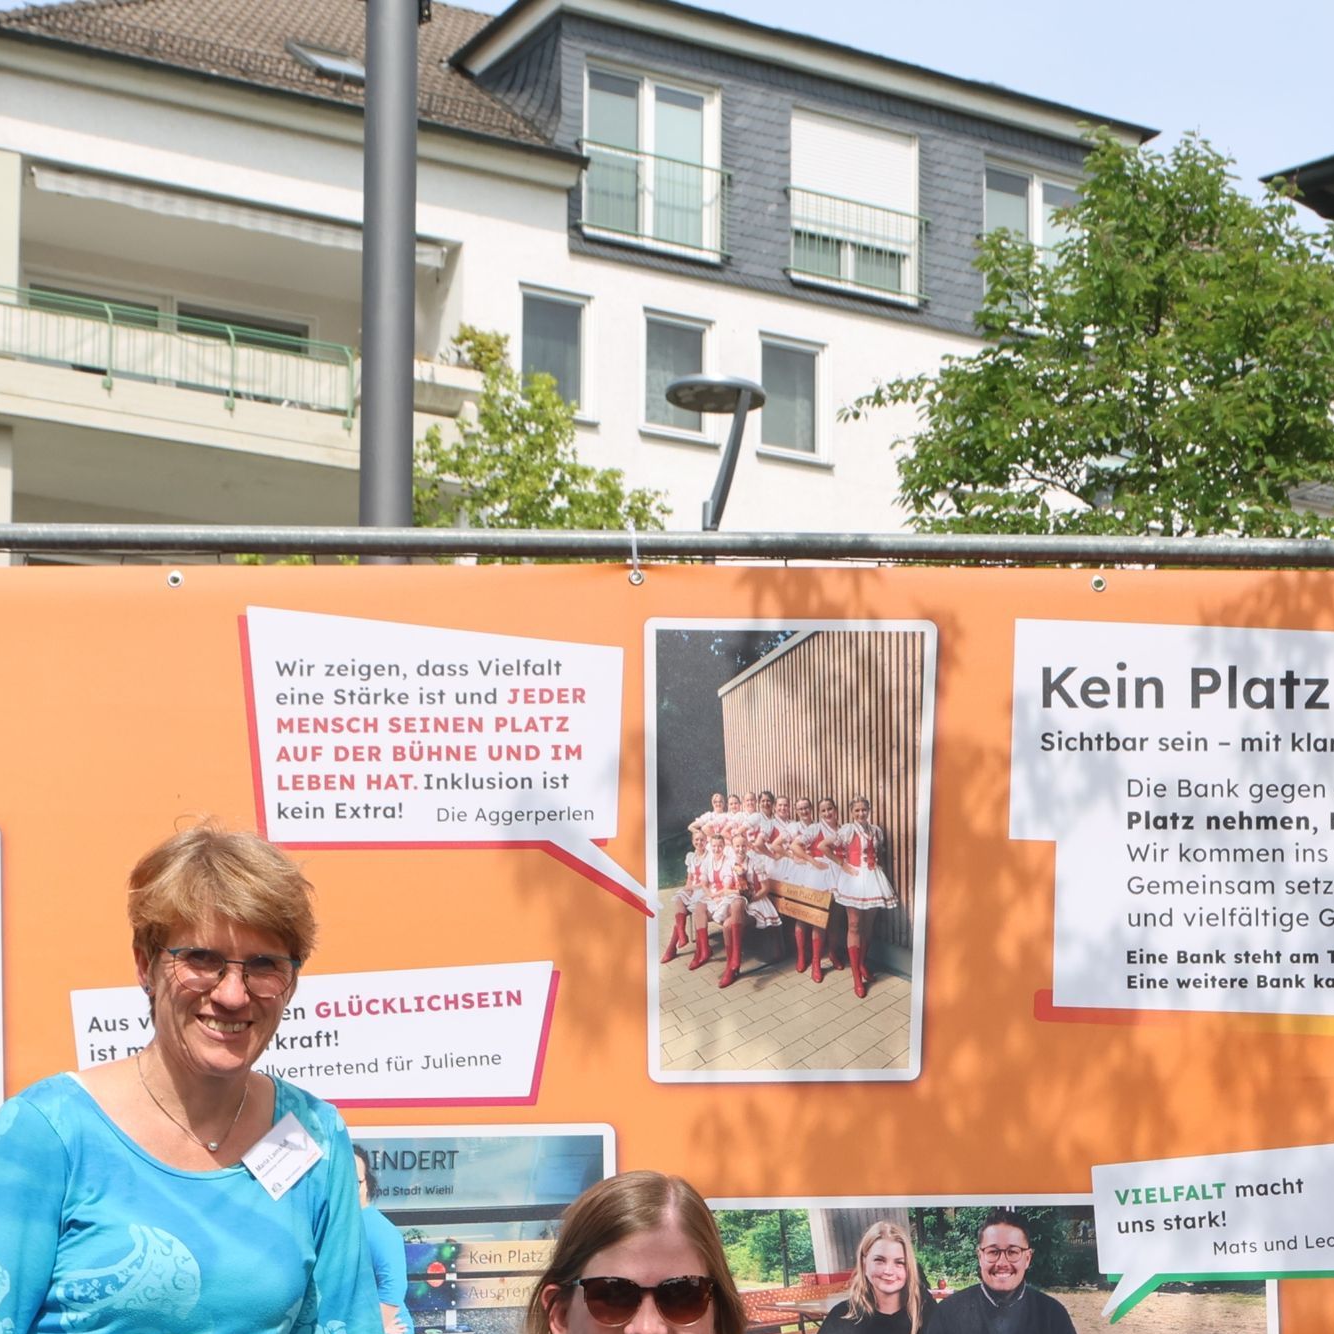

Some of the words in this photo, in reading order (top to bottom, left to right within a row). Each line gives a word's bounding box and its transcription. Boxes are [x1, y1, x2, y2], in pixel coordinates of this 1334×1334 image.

[275, 659, 315, 677] Wir
[325, 658, 407, 682] zeigen,
[416, 659, 469, 677] dass
[478, 658, 562, 676] Vielfalt
[276, 687, 324, 705] eine
[334, 687, 409, 705] Stärke
[419, 687, 446, 705] ist
[455, 687, 497, 705] und
[507, 688, 586, 704] JEDER
[1042, 662, 1164, 709] Kein
[1191, 665, 1330, 710] Platz
[277, 717, 378, 734] MENSCH
[388, 717, 483, 734] SEINEN
[495, 716, 569, 733] PLATZ
[276, 746, 323, 762] AUF
[334, 745, 381, 762] DER
[393, 740, 477, 762] BÜHNE
[488, 745, 540, 761] UND
[551, 744, 582, 761] IM
[1040, 730, 1149, 752] Sichtbar
[1158, 731, 1208, 752] sein
[1241, 731, 1282, 752] mit
[277, 774, 355, 791] LEBEN
[367, 774, 418, 790] HAT.
[424, 771, 532, 790] Inklusion
[543, 771, 569, 789] ist
[1127, 777, 1167, 798] Die
[1178, 778, 1239, 798] Bank
[1249, 783, 1325, 804] gegen
[277, 801, 324, 819] kein
[335, 802, 402, 819] Extra!
[437, 806, 467, 822] Die
[475, 806, 594, 826] Aggerperlen
[1127, 810, 1194, 830] Platz
[1206, 811, 1318, 835] nehmen,
[1126, 842, 1169, 862] Wir
[1179, 843, 1284, 863] kommen
[1295, 842, 1328, 862] ins
[1127, 874, 1275, 895] Gemeinsam
[1128, 907, 1173, 927] und
[1183, 906, 1309, 933] vielfältige
[1127, 948, 1168, 964] Eine
[1177, 949, 1226, 964] Bank
[1234, 949, 1282, 964] steht
[1289, 953, 1319, 964] am
[1127, 973, 1169, 989] Eine
[1176, 973, 1248, 989] weitere
[1257, 974, 1305, 989] Bank
[315, 990, 522, 1019] GLÜCKLICHSEIN
[88, 1016, 129, 1033] Aus
[90, 1043, 117, 1062] ist
[386, 1056, 413, 1072] für
[421, 1052, 502, 1070] Julienne
[1114, 1182, 1226, 1205] VIELFALT
[1235, 1178, 1304, 1198] macht
[1117, 1219, 1155, 1234] uns
[1163, 1211, 1226, 1231] stark!
[1213, 1240, 1257, 1256] Mats
[1264, 1235, 1298, 1252] und
